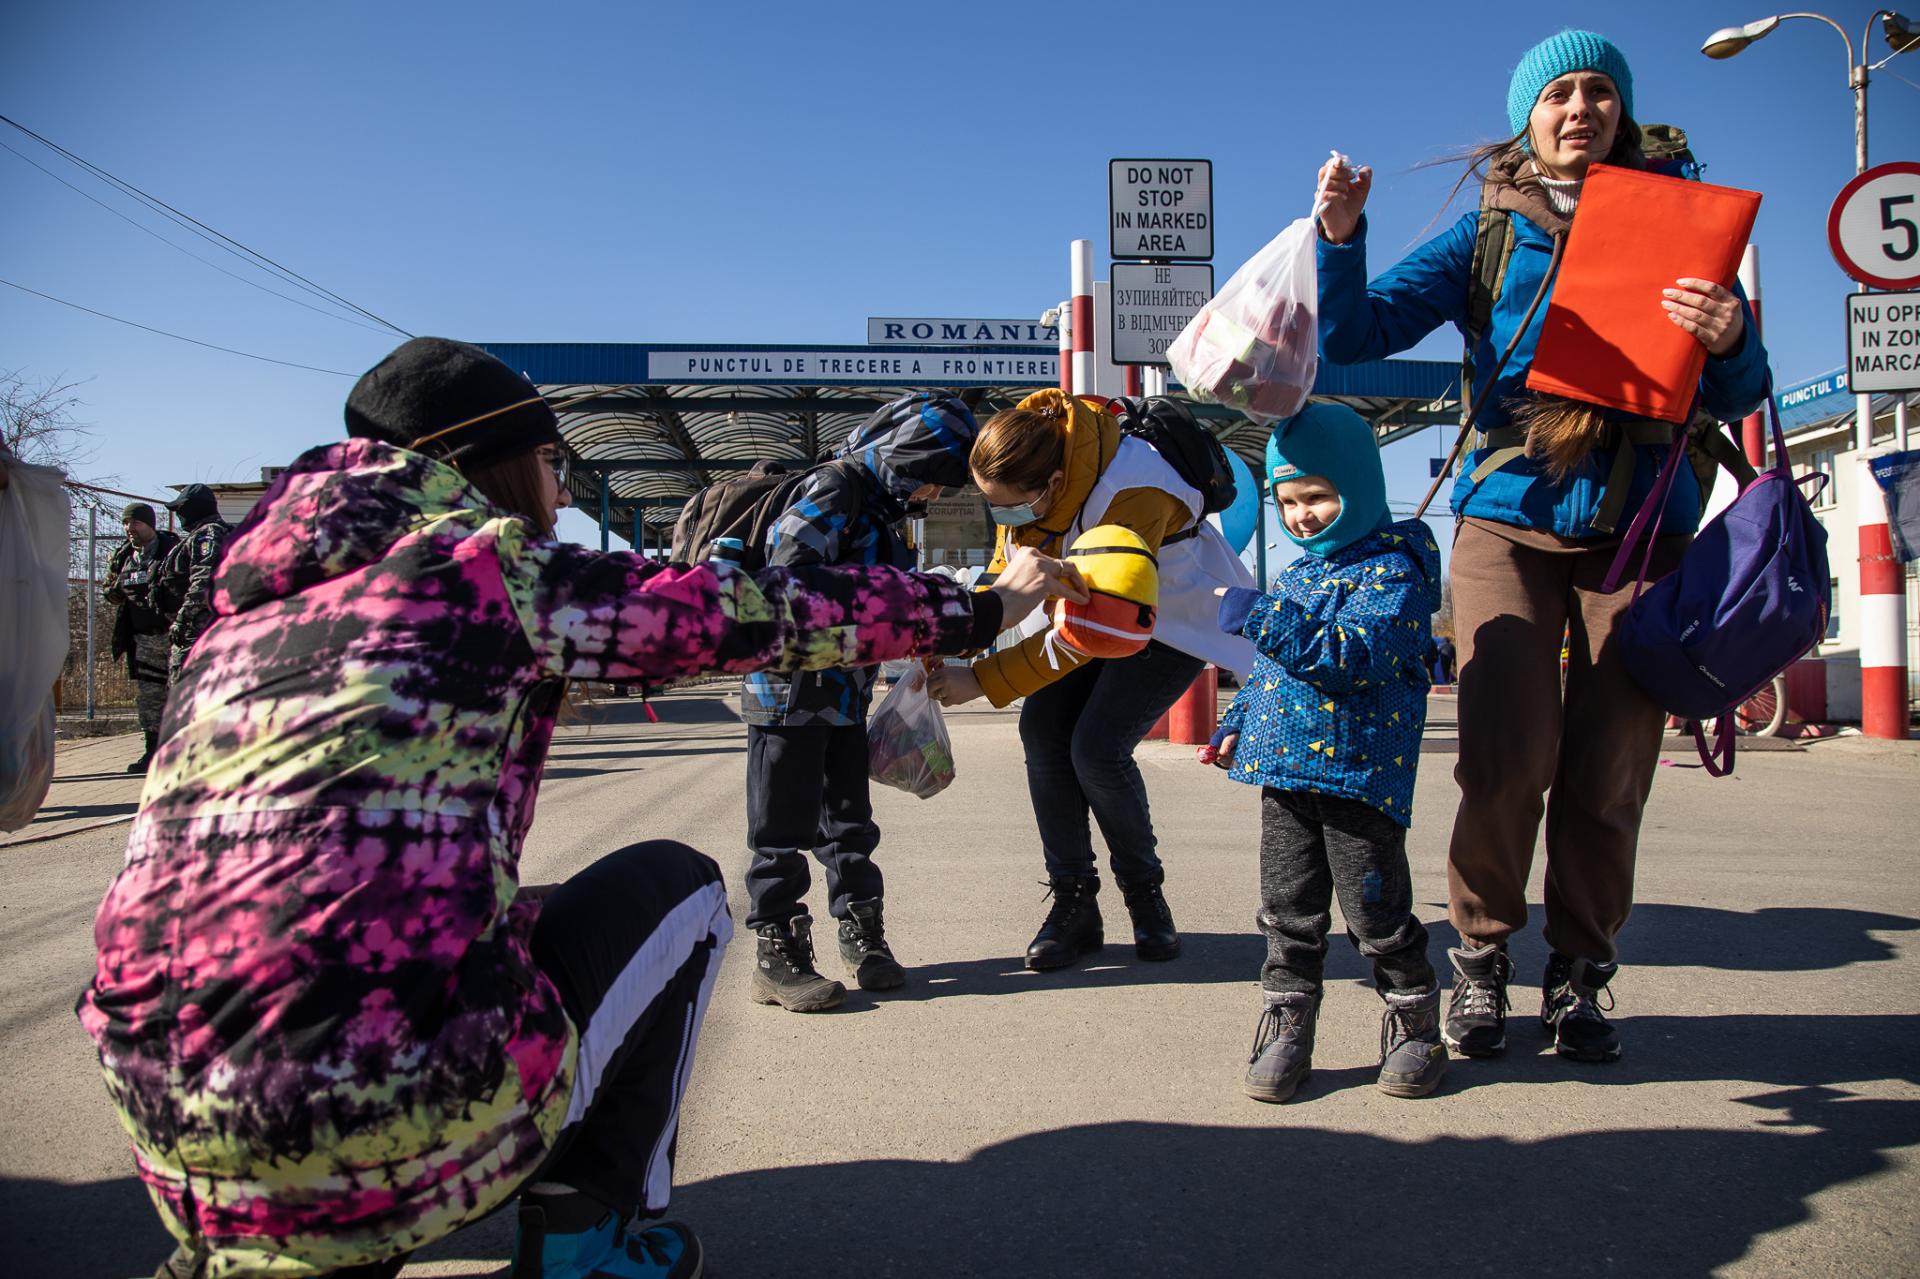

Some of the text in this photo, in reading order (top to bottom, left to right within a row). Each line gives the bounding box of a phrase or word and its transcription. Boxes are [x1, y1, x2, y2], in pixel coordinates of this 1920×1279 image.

[1128, 168, 1194, 185] DO NOT
[1138, 190, 1184, 207] STOP
[1115, 212, 1207, 230] IN MARKED
[1879, 194, 1919, 262] 5
[1137, 234, 1186, 251] AREA
[1154, 267, 1171, 284] НЕ
[1117, 314, 1126, 330] В
[1853, 306, 1879, 324] NU
[1862, 331, 1880, 348] IN
[688, 358, 1056, 375] PUNCTUL DE TRECERE A FRONTIEREI
[1781, 379, 1832, 408] PUNCTUL
